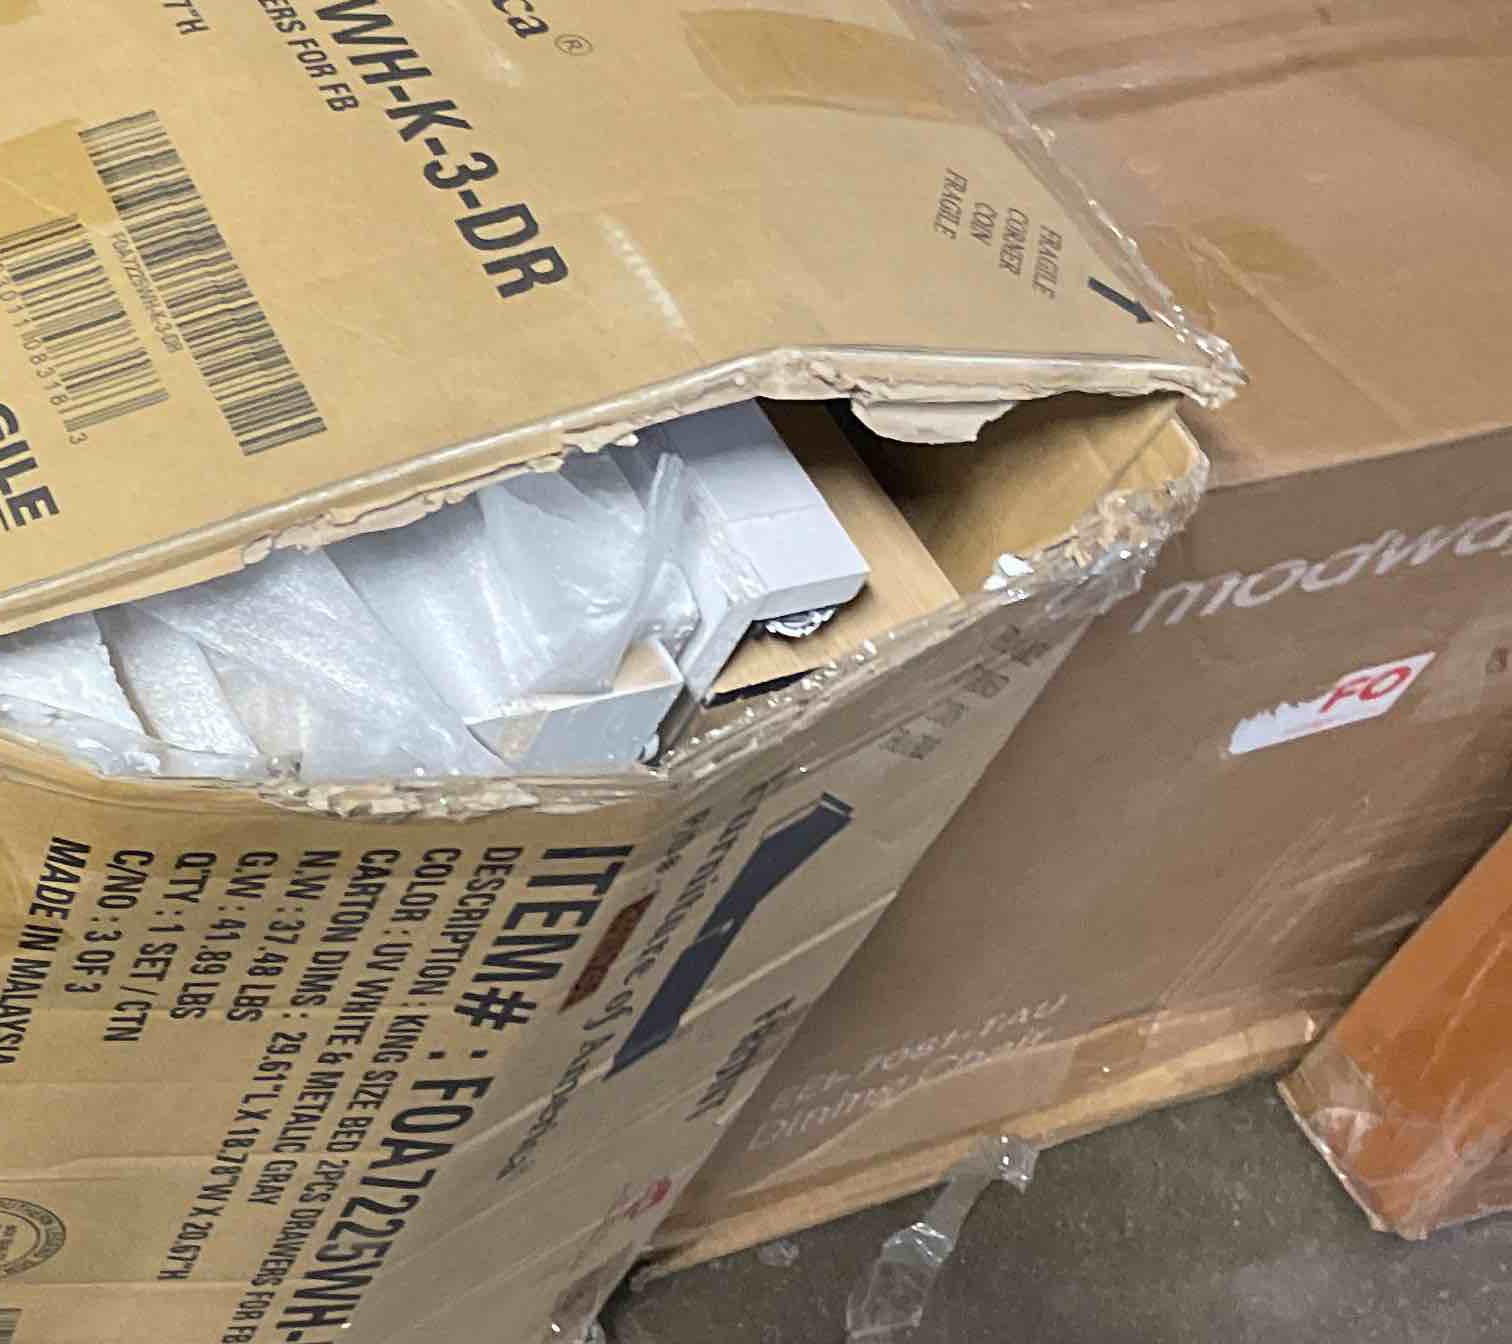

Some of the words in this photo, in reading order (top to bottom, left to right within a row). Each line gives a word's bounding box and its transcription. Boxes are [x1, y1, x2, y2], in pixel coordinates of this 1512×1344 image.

[284, 36, 340, 79] FOR
[315, 80, 362, 112] FB
[934, 167, 968, 240] FRAGILE
[970, 202, 998, 247] COIN
[1033, 224, 1062, 300] FRAGILE
[28, 834, 94, 925] MADE
[93, 849, 157, 909] C/NO
[222, 851, 280, 898] G.W
[281, 850, 342, 899] N.W
[321, 848, 401, 941] CARTON
[388, 846, 464, 921] COLOR
[407, 846, 524, 994] DESCRIPTION
[442, 843, 635, 1031] ITEM#
[29, 930, 65, 960] IN
[69, 949, 117, 975] OF
[127, 942, 179, 980] SET
[188, 918, 250, 974] 41.89
[243, 918, 308, 977] 37.48
[362, 942, 413, 971] UV
[166, 981, 219, 1019] LBS
[224, 983, 276, 1022] LBS
[288, 951, 350, 1005] DIMS
[101, 1000, 153, 1041] CTN
[322, 978, 394, 1046] WHITE
[369, 1014, 428, 1063] KING
[240, 1031, 307, 1103] 29.61"L
[342, 1069, 400, 1110] SIZE
[268, 1071, 346, 1153] METALIC
[322, 1116, 374, 1152] BED
[245, 1159, 299, 1205] GRAY
[296, 1159, 350, 1203] 2PCS
[247, 1209, 323, 1286] DRAWERS
[231, 1291, 277, 1320] FOR
[218, 1325, 257, 1343] FB
